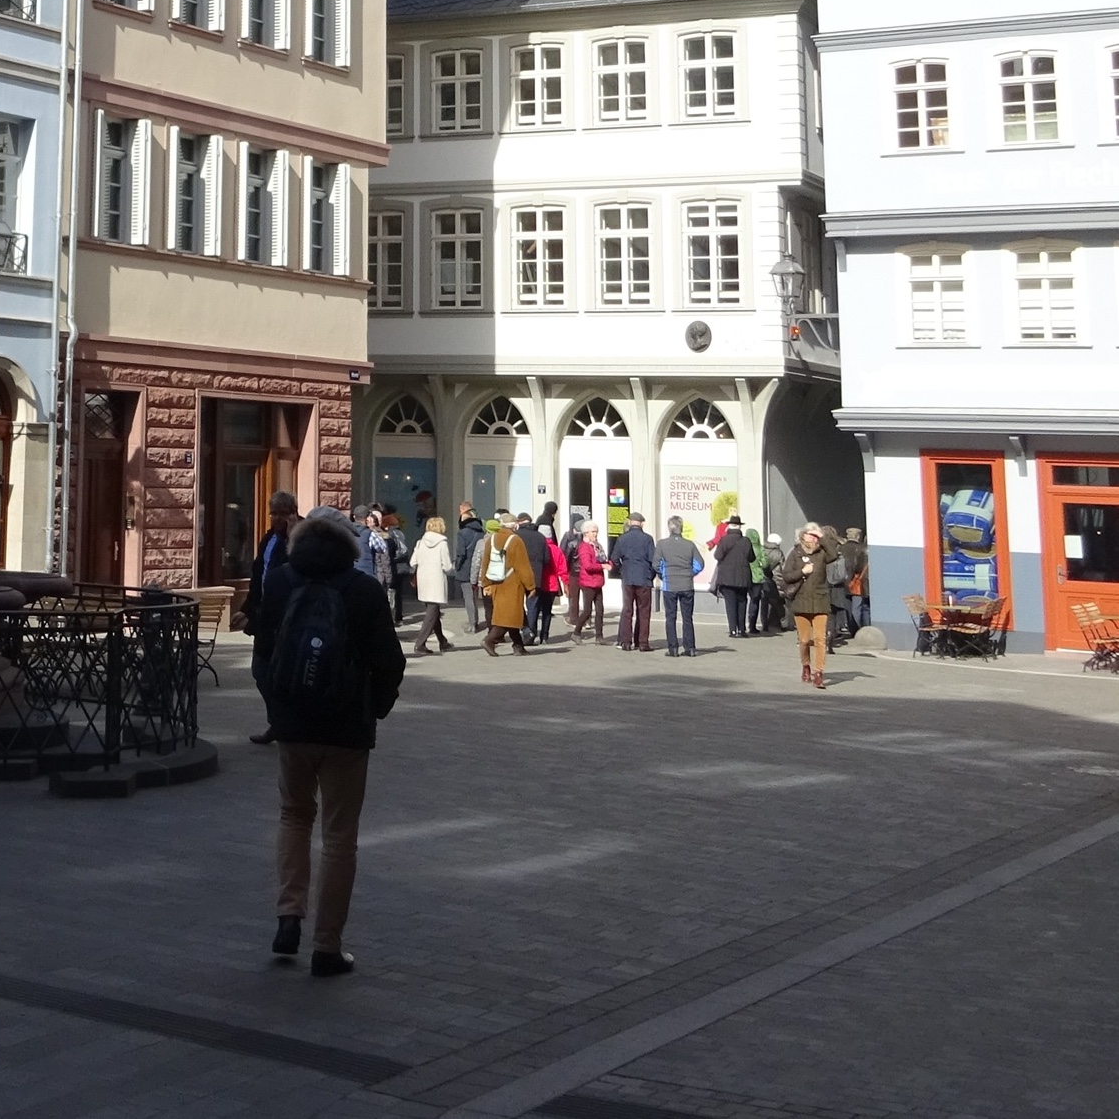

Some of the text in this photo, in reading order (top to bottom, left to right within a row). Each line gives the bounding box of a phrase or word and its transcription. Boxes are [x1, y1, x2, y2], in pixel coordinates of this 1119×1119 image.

[669, 481, 721, 492] STRUWWEL
[669, 491, 700, 501] PETER
[670, 501, 713, 512] MUSEUM
